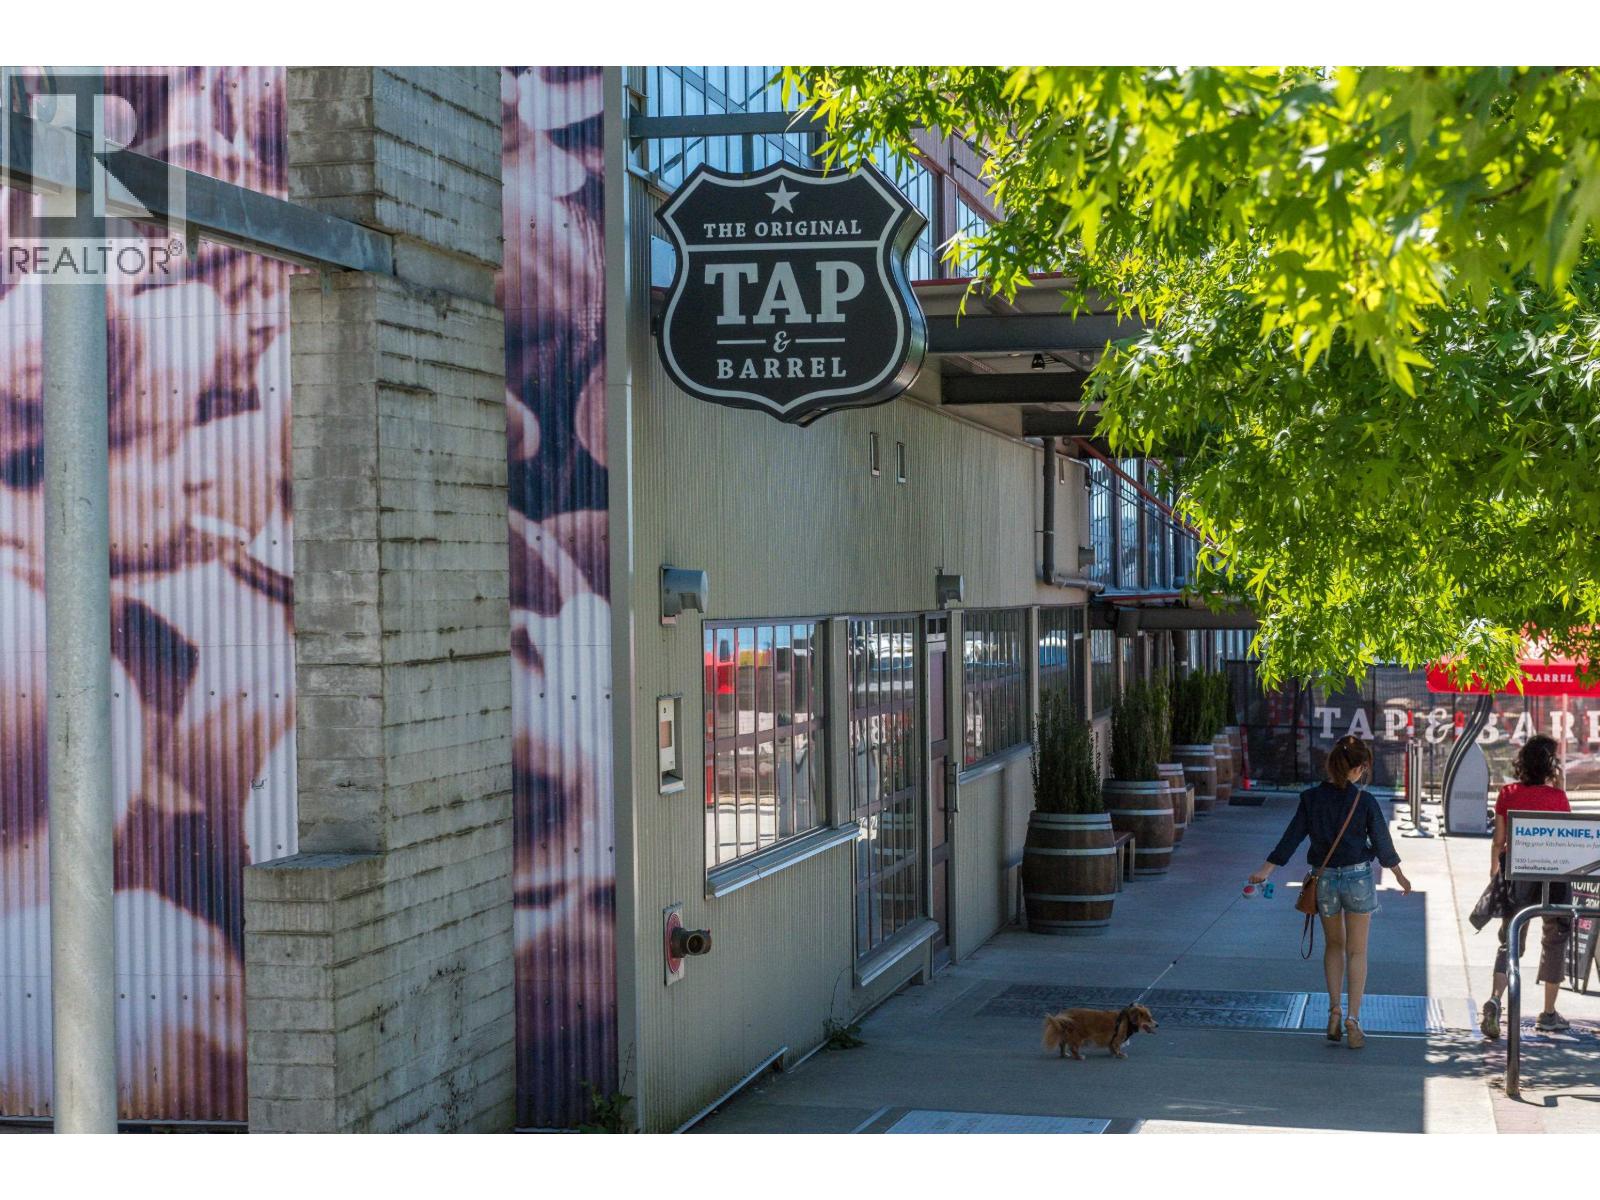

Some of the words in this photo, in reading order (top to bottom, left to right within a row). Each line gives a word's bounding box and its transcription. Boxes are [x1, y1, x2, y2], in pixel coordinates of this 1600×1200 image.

[704, 222, 747, 239] THE
[754, 219, 862, 237] ORIGINAL
[704, 260, 865, 325] TAP
[773, 330, 791, 353] &
[716, 356, 847, 380] BARREL
[1314, 707, 1409, 741] TAP
[1425, 707, 1455, 744] &
[1515, 826, 1555, 837] HAPPY
[1557, 828, 1594, 839] KNIFE,
